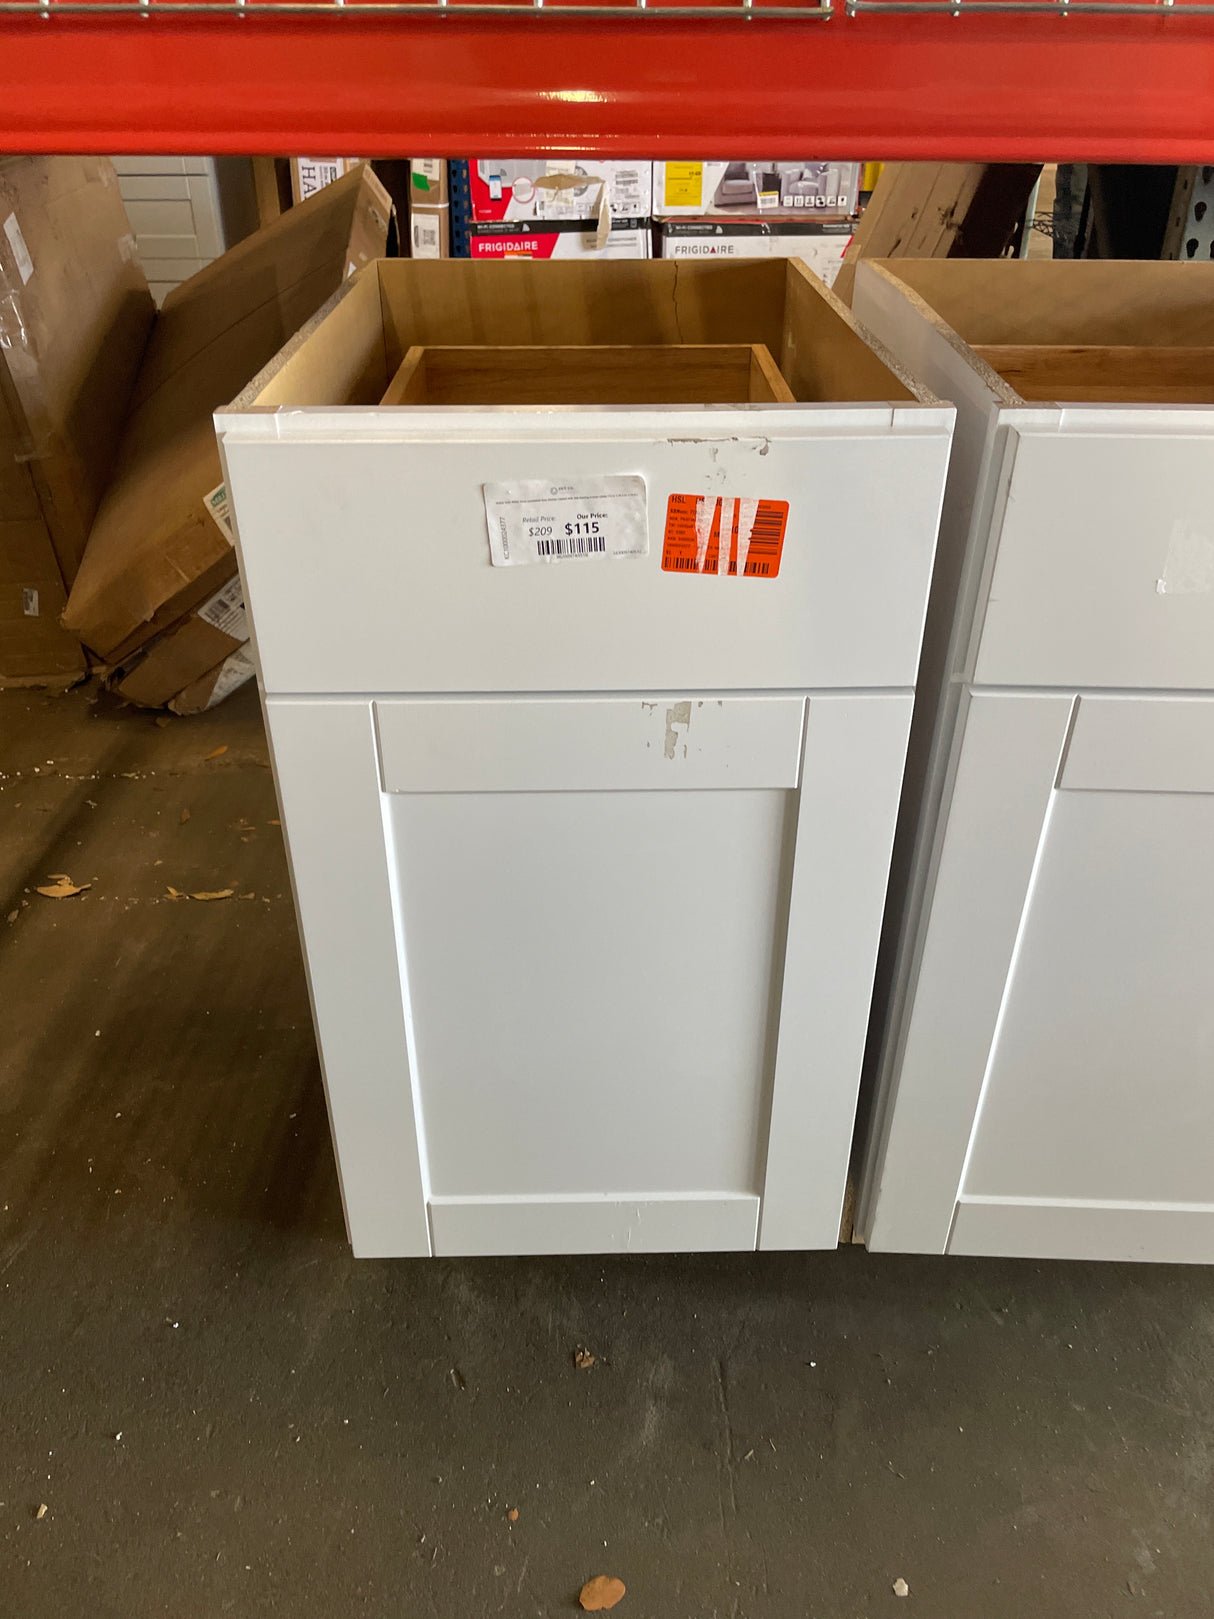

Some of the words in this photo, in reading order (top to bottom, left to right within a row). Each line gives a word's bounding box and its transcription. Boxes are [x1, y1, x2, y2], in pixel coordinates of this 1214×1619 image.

[478, 241, 538, 252] FRIGIDAIRE
[674, 245, 735, 255] FRIGIDAIRE
[528, 526, 553, 537] $209
[564, 521, 600, 536] $115
